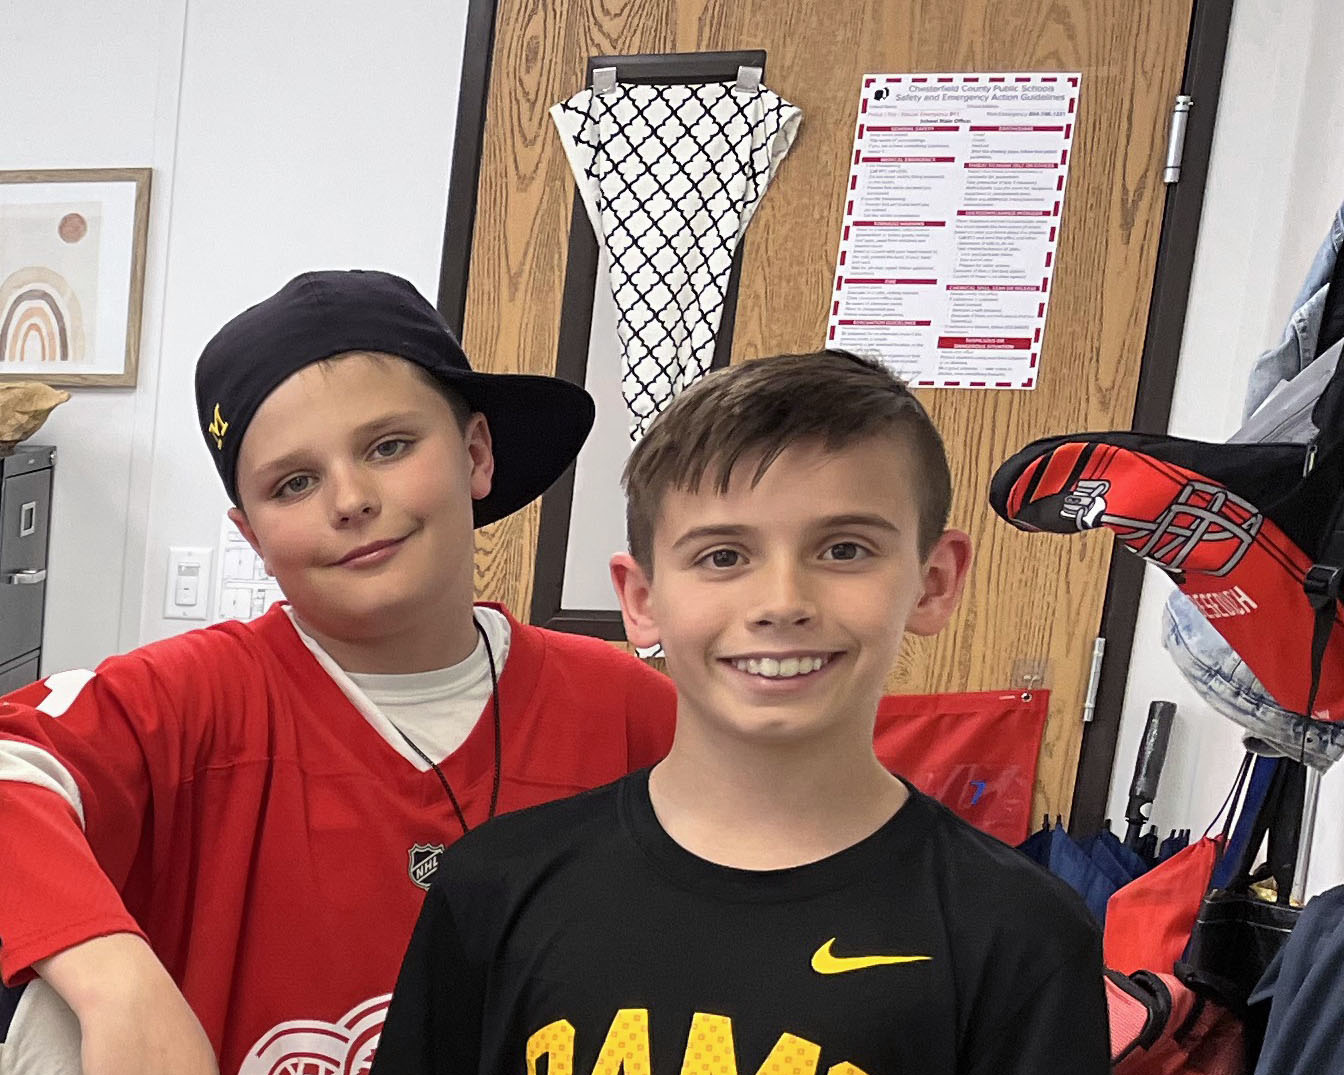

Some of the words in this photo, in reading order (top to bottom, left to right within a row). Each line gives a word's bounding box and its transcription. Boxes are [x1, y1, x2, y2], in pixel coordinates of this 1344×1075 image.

[908, 84, 960, 93] Chesterfield
[961, 84, 990, 94] County
[993, 84, 1019, 93] Public
[1021, 84, 1055, 93] Schools
[896, 93, 922, 102] Safety
[924, 93, 940, 101] and
[942, 93, 989, 103] Emergency
[991, 93, 1018, 101] Action
[1020, 93, 1066, 101] Guidelines
[415, 855, 440, 881] NHL
